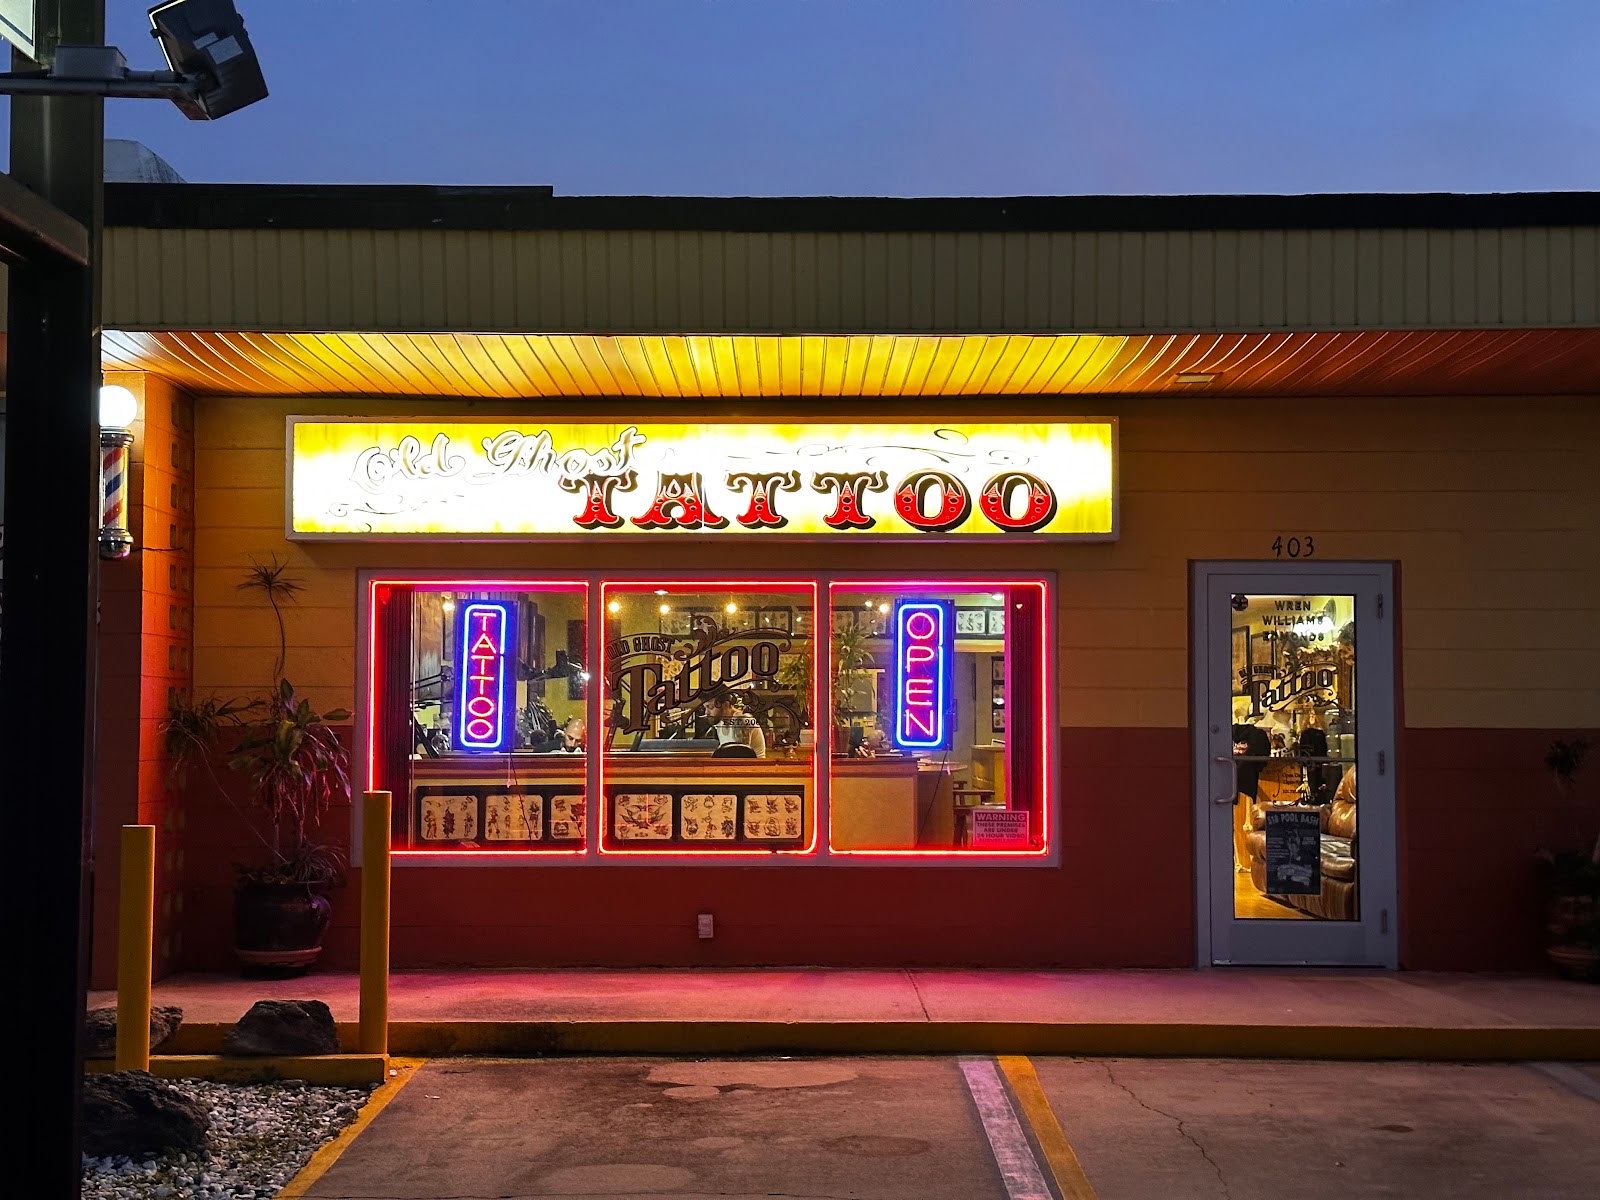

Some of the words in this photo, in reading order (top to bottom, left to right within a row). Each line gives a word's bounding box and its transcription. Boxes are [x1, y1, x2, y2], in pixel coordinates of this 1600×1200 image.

[350, 433, 466, 494] Old
[481, 426, 647, 477] Ghost
[557, 468, 1058, 533] TATTOO
[1271, 536, 1315, 558] 403
[1261, 615, 1324, 626] WILLIAMS
[1274, 600, 1311, 611] WREN
[632, 636, 676, 654] GHOST
[466, 611, 497, 740] TATTOO
[610, 641, 780, 736] Tattoo
[904, 611, 936, 738] OPEN
[1241, 668, 1335, 718] Tattoo
[976, 813, 1025, 821] WARNING
[1280, 813, 1299, 823] POOL
